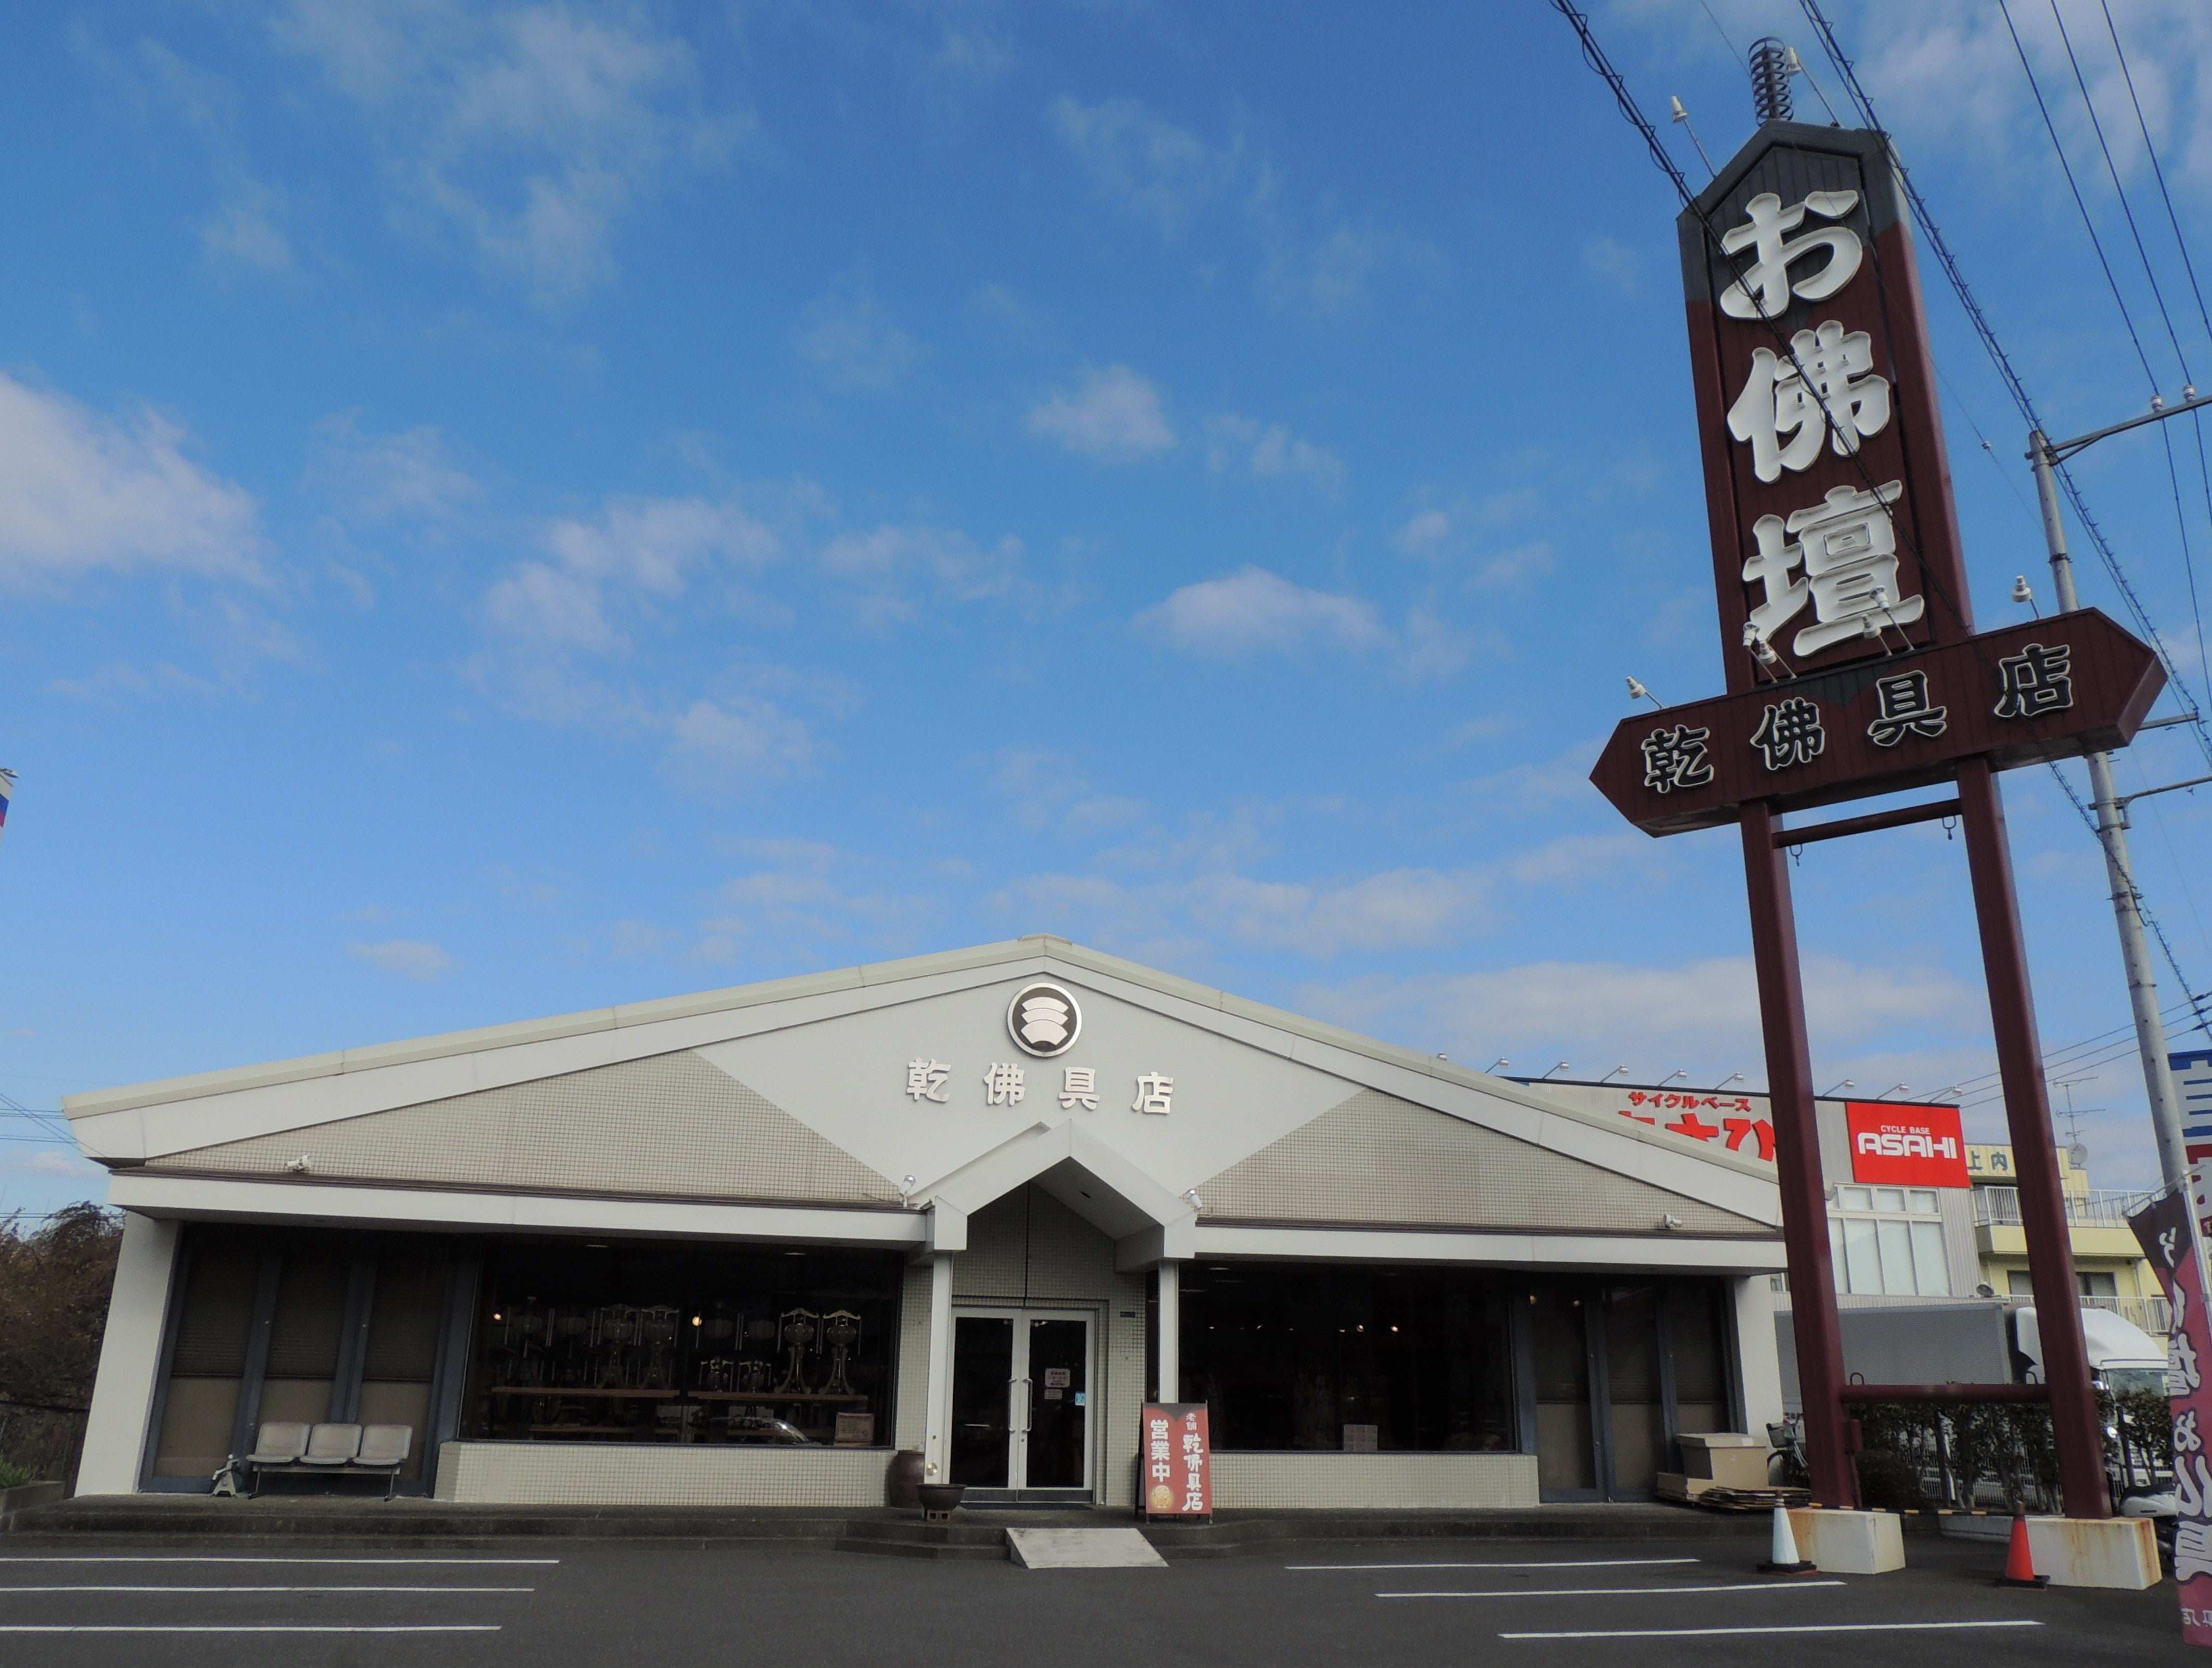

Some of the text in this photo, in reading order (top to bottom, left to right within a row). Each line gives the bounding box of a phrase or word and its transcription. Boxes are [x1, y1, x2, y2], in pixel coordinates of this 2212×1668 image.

[1720, 190, 1925, 657] お佛壇
[1641, 643, 2074, 794] 乾佛具店
[906, 1057, 1174, 1115] 乾佛具店
[1629, 1091, 1752, 1112] サイクルベース
[1857, 1132, 1958, 1159] ASAHI
[1880, 1124, 1931, 1135] CYCLE BASE
[1150, 1419, 1171, 1482] 営業中
